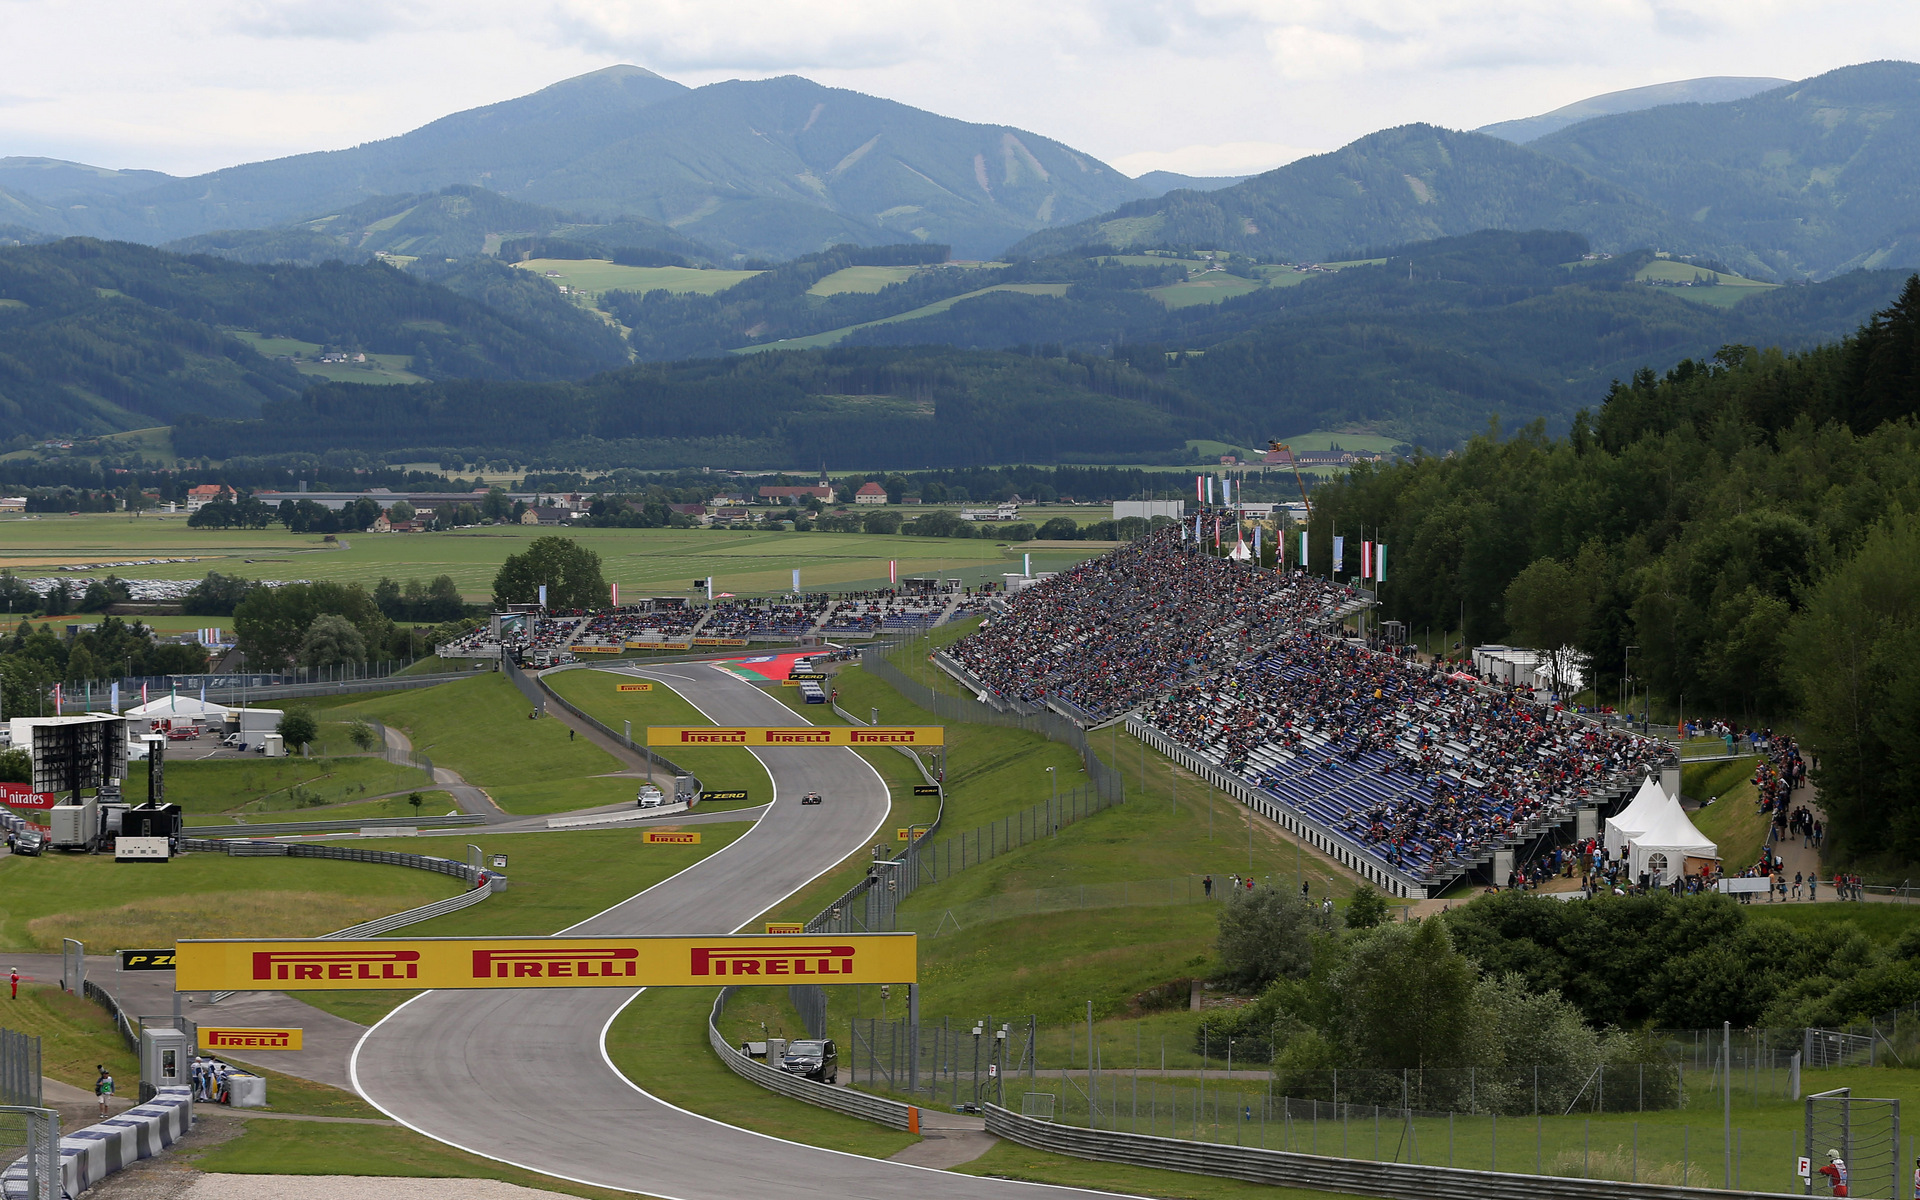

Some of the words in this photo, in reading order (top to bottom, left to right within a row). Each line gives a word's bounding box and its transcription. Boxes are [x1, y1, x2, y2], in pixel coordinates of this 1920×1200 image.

[681, 730, 746, 743] PIRELLI
[766, 730, 830, 743] PIRELLI
[851, 730, 915, 743] PIRELLI
[650, 834, 694, 843] PIRELLI
[128, 956, 147, 966] P
[253, 951, 421, 980] PIRELLI
[473, 949, 639, 978] PIRELLI
[691, 946, 856, 976] PIRELLI
[209, 1031, 290, 1047] PIRELLI
[1800, 1161, 1808, 1172] F
